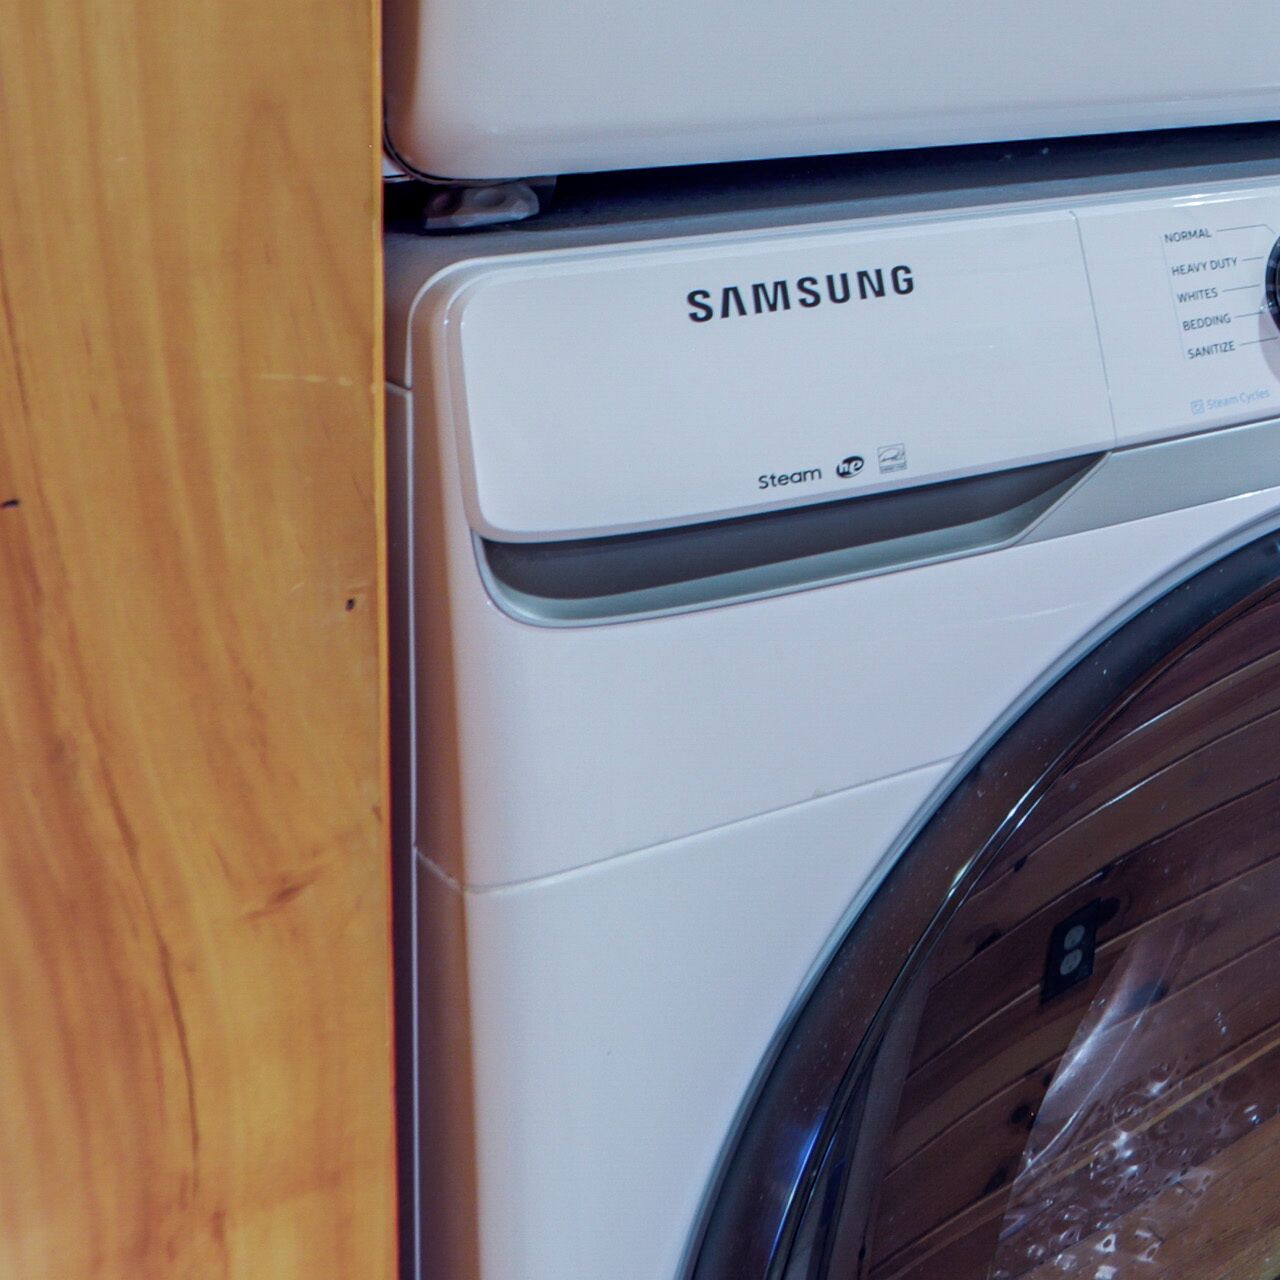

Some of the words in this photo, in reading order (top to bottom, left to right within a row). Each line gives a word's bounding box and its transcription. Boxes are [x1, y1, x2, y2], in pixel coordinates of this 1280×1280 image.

[1164, 228, 1212, 243] NORMAL
[1171, 261, 1208, 276] HEAVY
[1209, 257, 1238, 271] DUTY
[687, 265, 914, 323] SAMSUNG
[1177, 288, 1218, 303] WHITES
[1182, 314, 1232, 331] BEDDING
[1188, 341, 1236, 359] SANITIZE
[1207, 395, 1239, 411] Steam
[1239, 388, 1270, 405] Cycles
[758, 466, 821, 489] Steam
